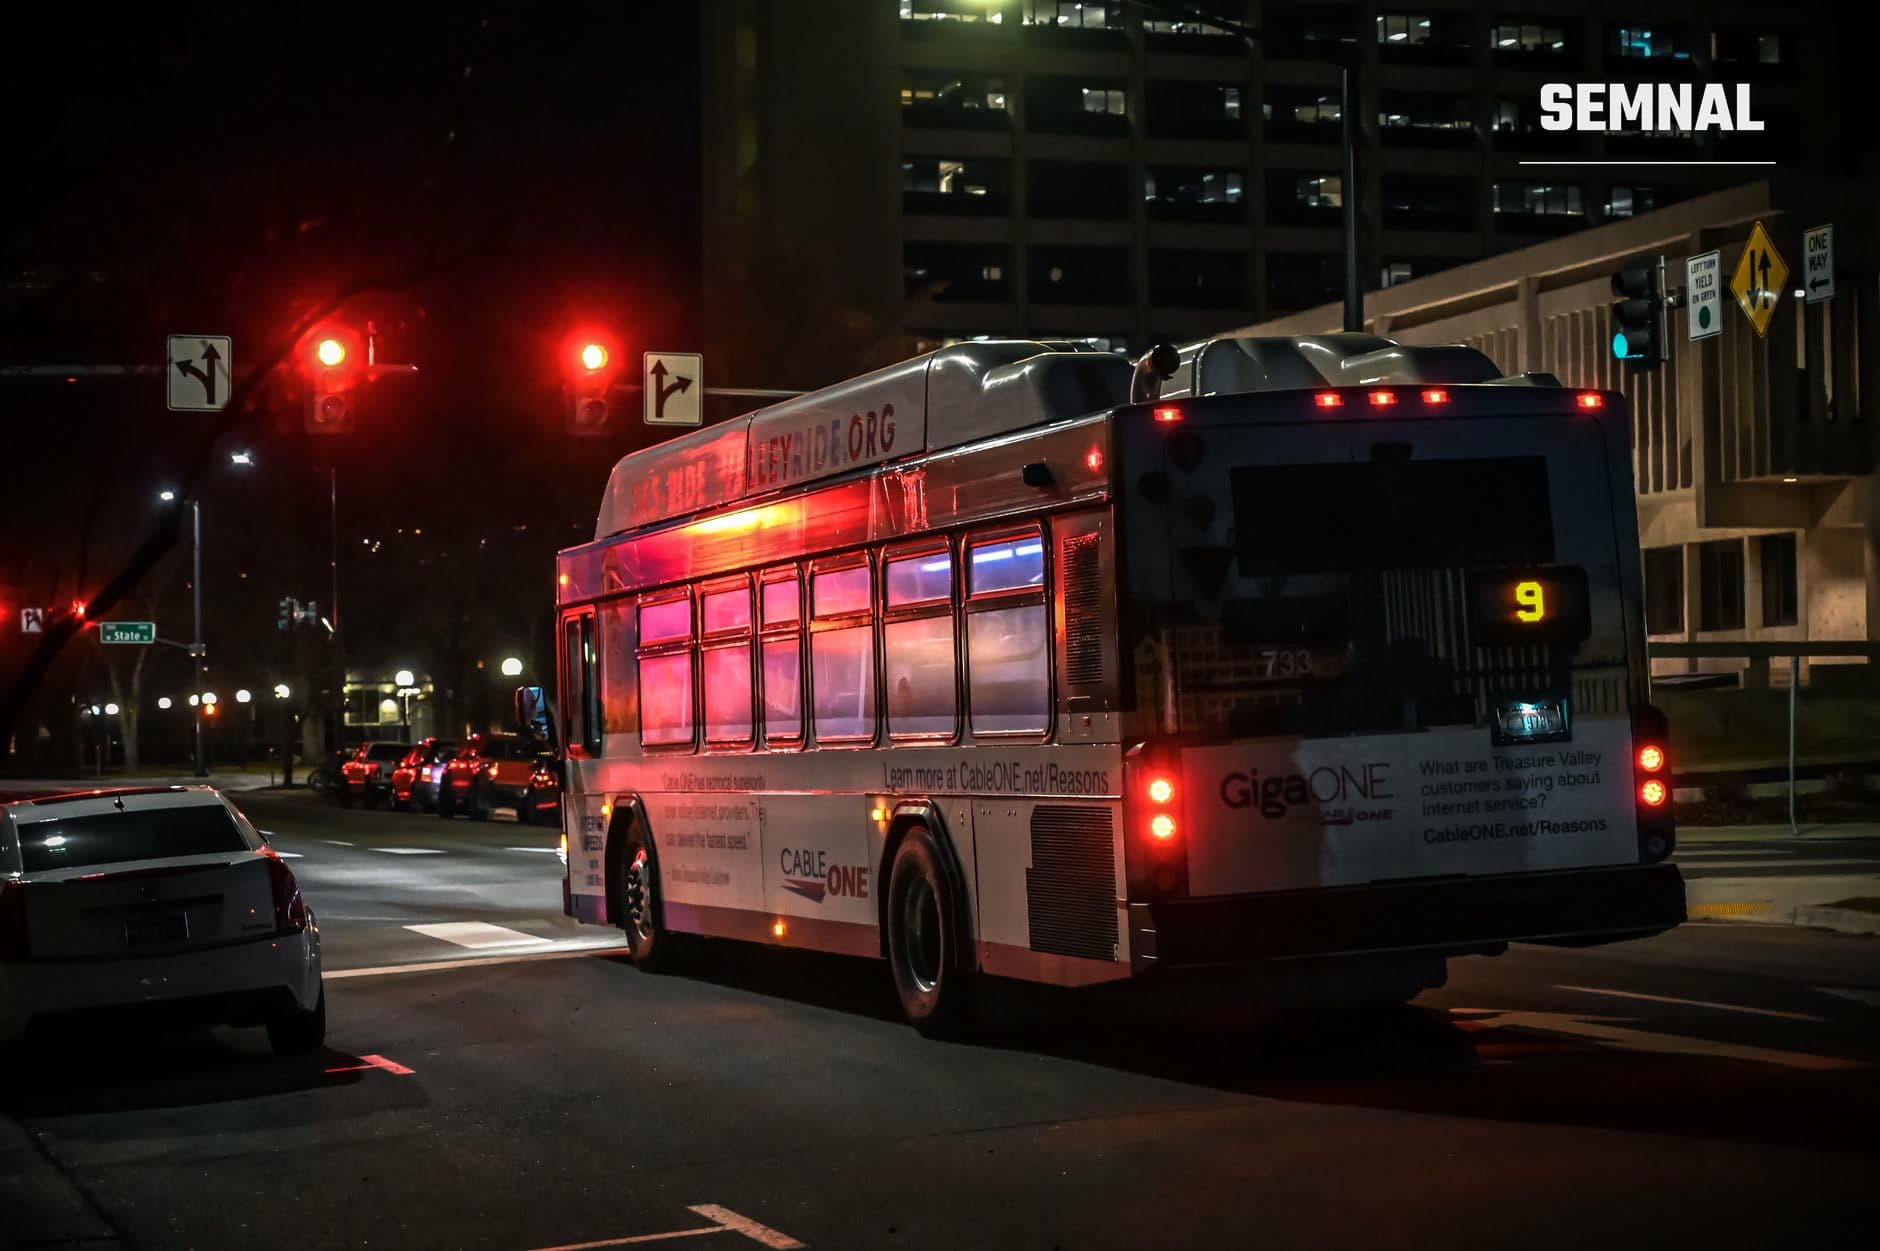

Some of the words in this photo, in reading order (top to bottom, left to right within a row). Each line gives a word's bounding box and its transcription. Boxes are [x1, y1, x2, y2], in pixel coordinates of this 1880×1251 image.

[1809, 232, 1827, 253] ONE
[1809, 252, 1828, 272] WAY
[1695, 273, 1713, 291] YIELD
[1692, 293, 1700, 305] ON
[1701, 288, 1717, 303] GREEN
[1515, 581, 1544, 622] 9
[114, 631, 141, 642] State
[1262, 648, 1312, 676] 733
[1420, 759, 1459, 776] What
[1464, 759, 1488, 774] are
[1492, 755, 1555, 771] Treasure
[1559, 750, 1601, 768] Valley
[884, 761, 913, 790] Learn
[916, 769, 944, 789] more
[947, 767, 957, 789] at
[960, 762, 1109, 794] CableONE.net/Reasons
[1220, 761, 1395, 820] GigaONE
[1421, 778, 1501, 798] customers
[1505, 774, 1554, 793] saying
[1558, 770, 1600, 787] about
[1423, 800, 1479, 816] Internet
[1485, 793, 1546, 812] service?
[1424, 817, 1607, 844] CableONE.net/Reasons
[781, 847, 827, 879] CABLE
[827, 864, 869, 899] ONE
